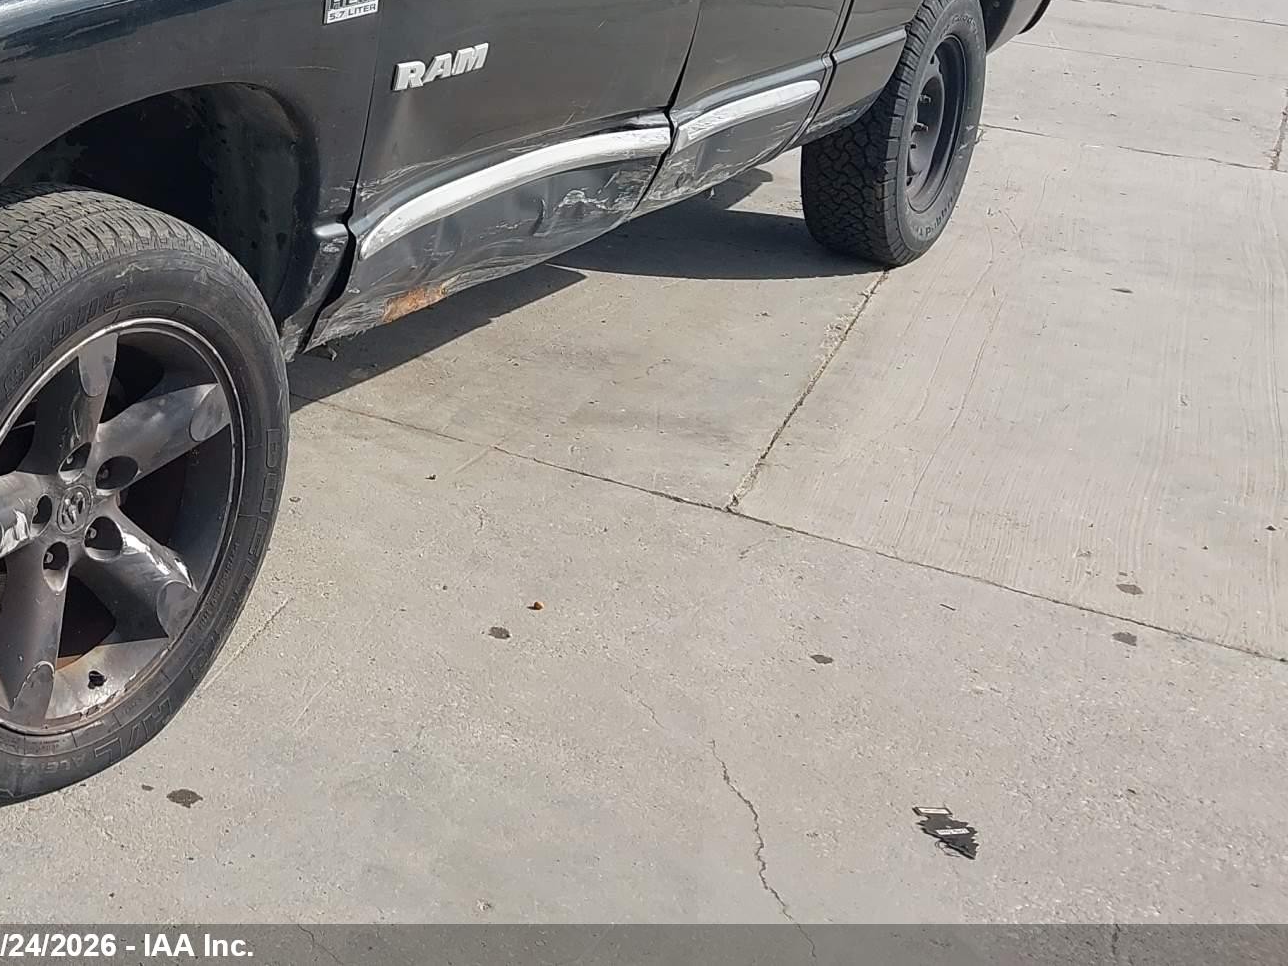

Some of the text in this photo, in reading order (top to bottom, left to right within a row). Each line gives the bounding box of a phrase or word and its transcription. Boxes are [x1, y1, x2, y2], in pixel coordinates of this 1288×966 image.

[329, 4, 377, 21] 5.7 LITER
[393, 42, 490, 91] RAM
